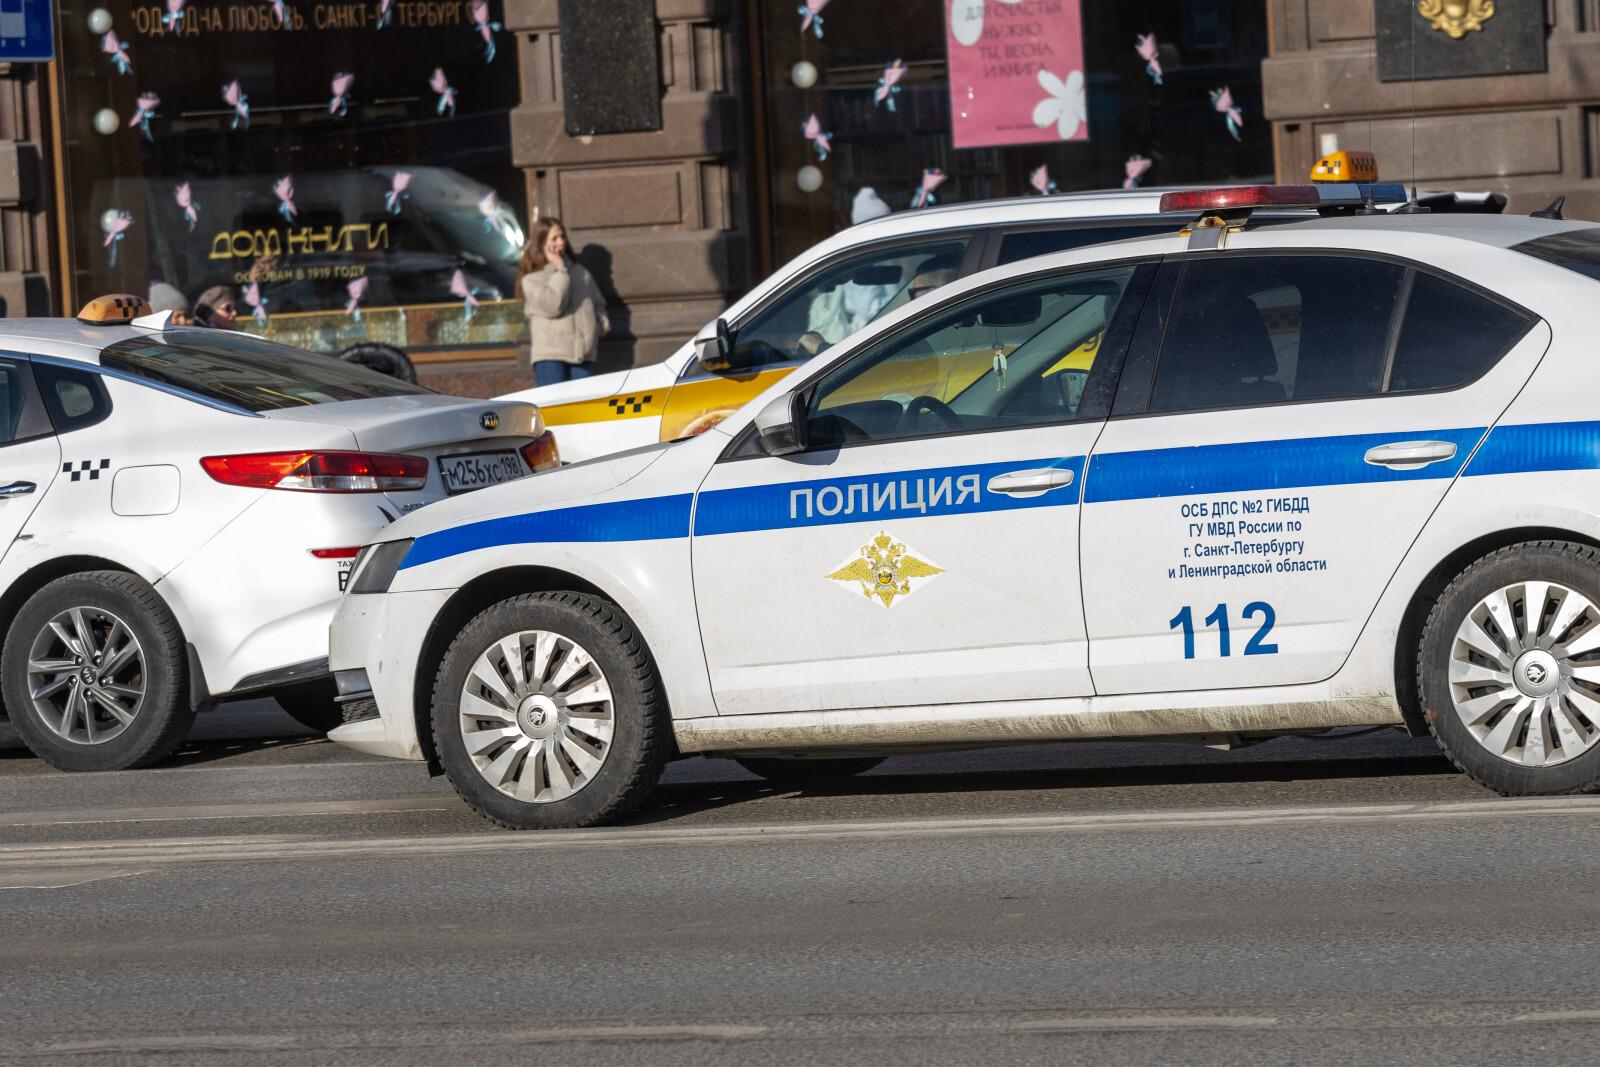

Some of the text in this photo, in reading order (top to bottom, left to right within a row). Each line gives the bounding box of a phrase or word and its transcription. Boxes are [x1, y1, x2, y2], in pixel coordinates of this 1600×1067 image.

[984, 65, 996, 79] И
[209, 222, 389, 260] ДОМ КНИГИ
[308, 267, 331, 280] 1919
[334, 265, 366, 279] ГОДУ
[790, 473, 981, 519] ПОЛИЦИЯ
[1181, 497, 1310, 518] ОСБ ДПС №2 ГИБДД
[1189, 521, 1302, 537] ГУ МВД России по
[1184, 539, 1304, 558] г. Санкт-Петербургу
[1168, 558, 1327, 579] и Ленинградской области
[1169, 601, 1278, 660] 112
